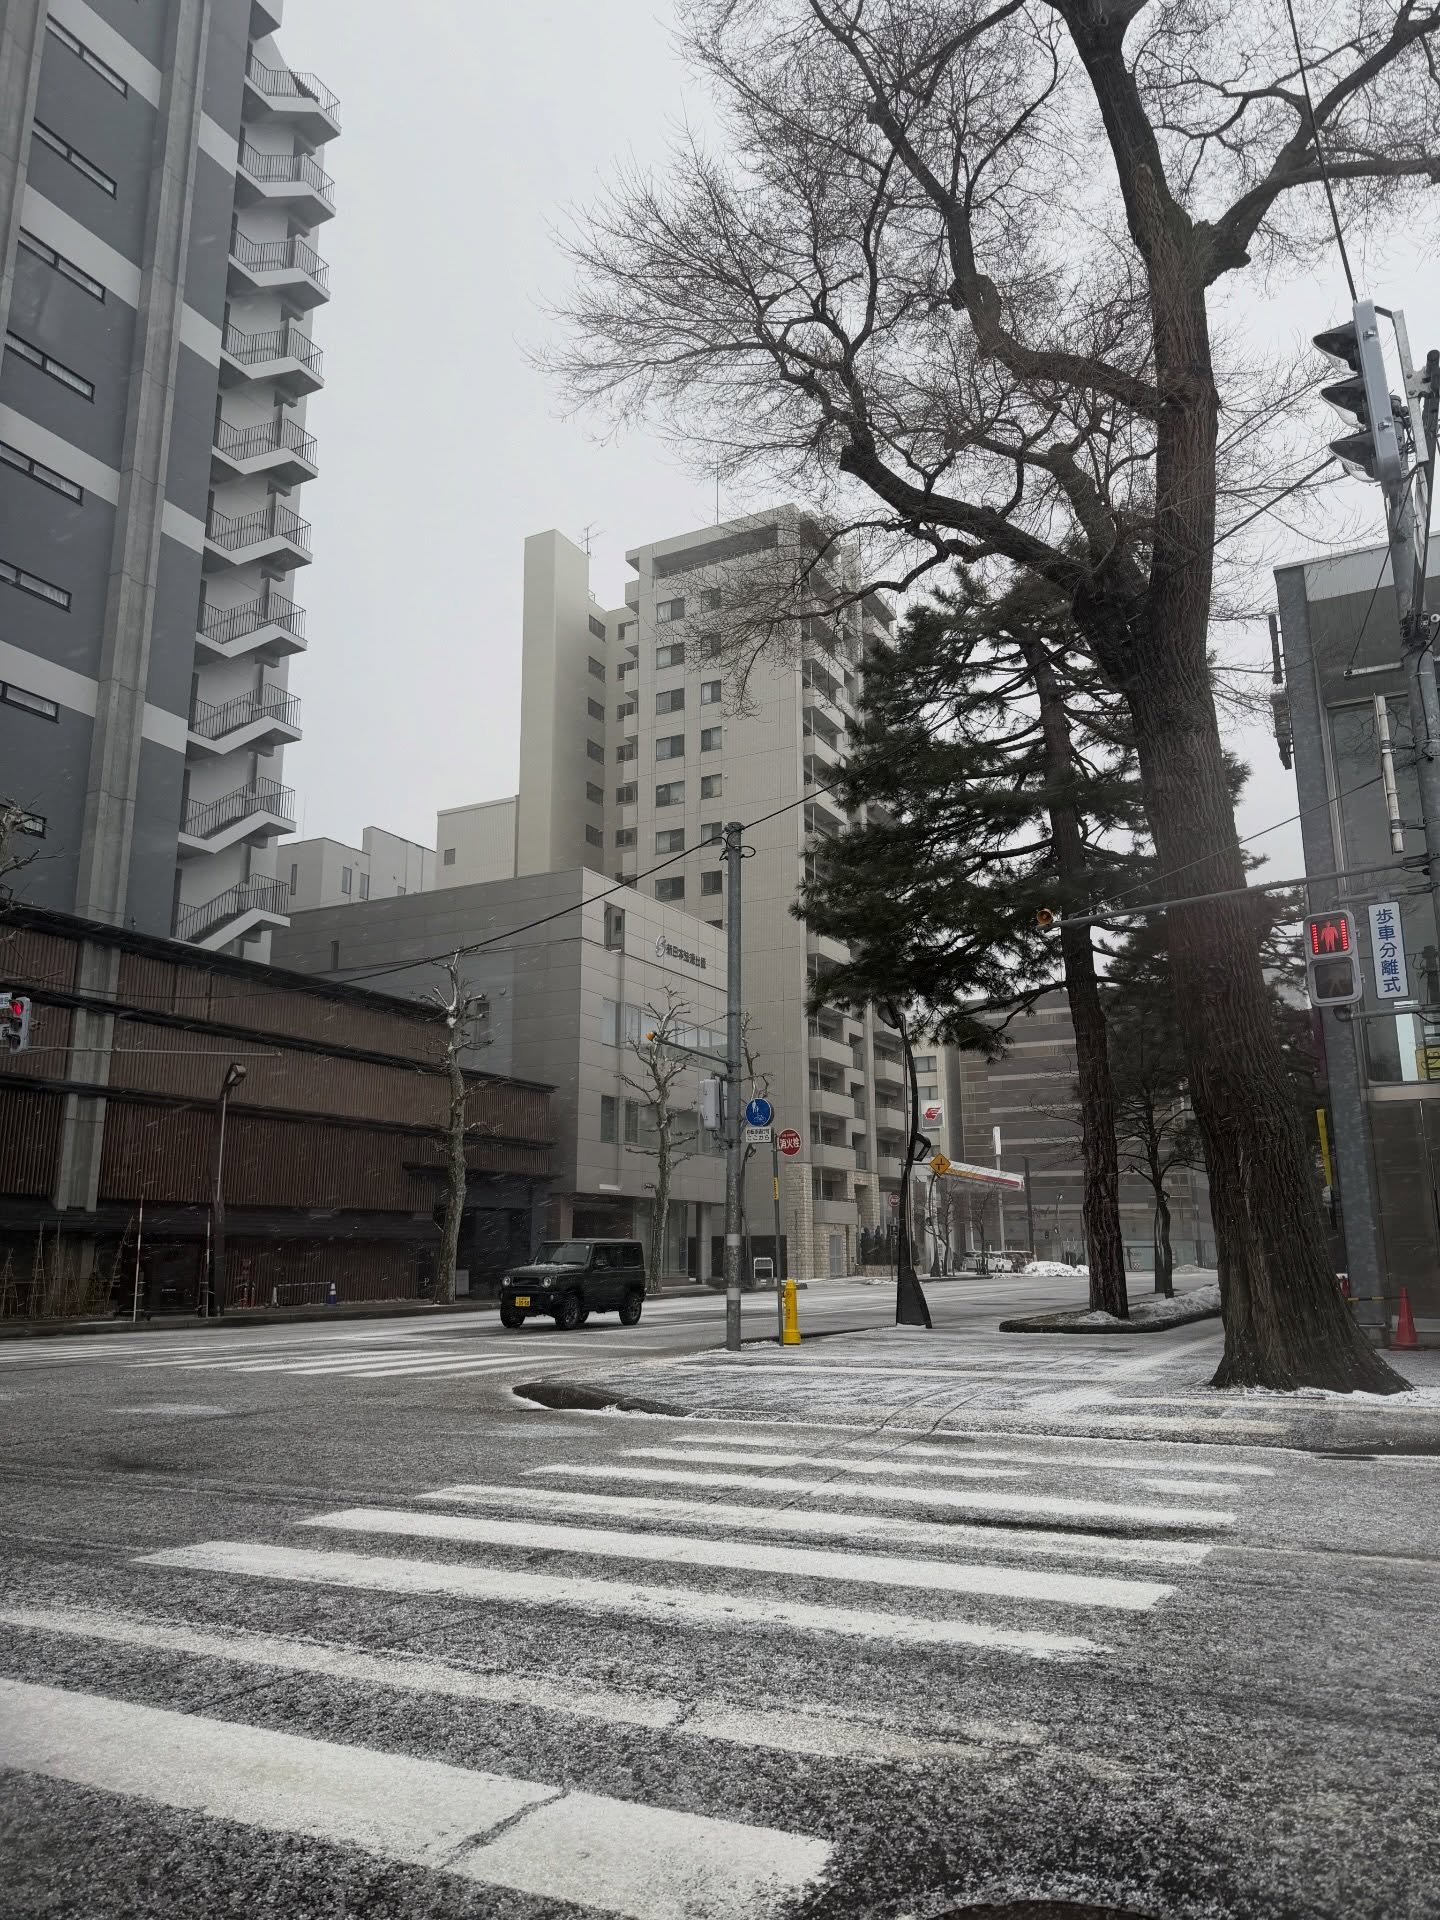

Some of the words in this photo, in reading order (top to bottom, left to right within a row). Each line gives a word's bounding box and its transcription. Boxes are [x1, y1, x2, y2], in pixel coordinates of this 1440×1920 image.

[1376, 909, 1401, 993] 歩車分離式
[780, 1137, 800, 1149] 消火栓
